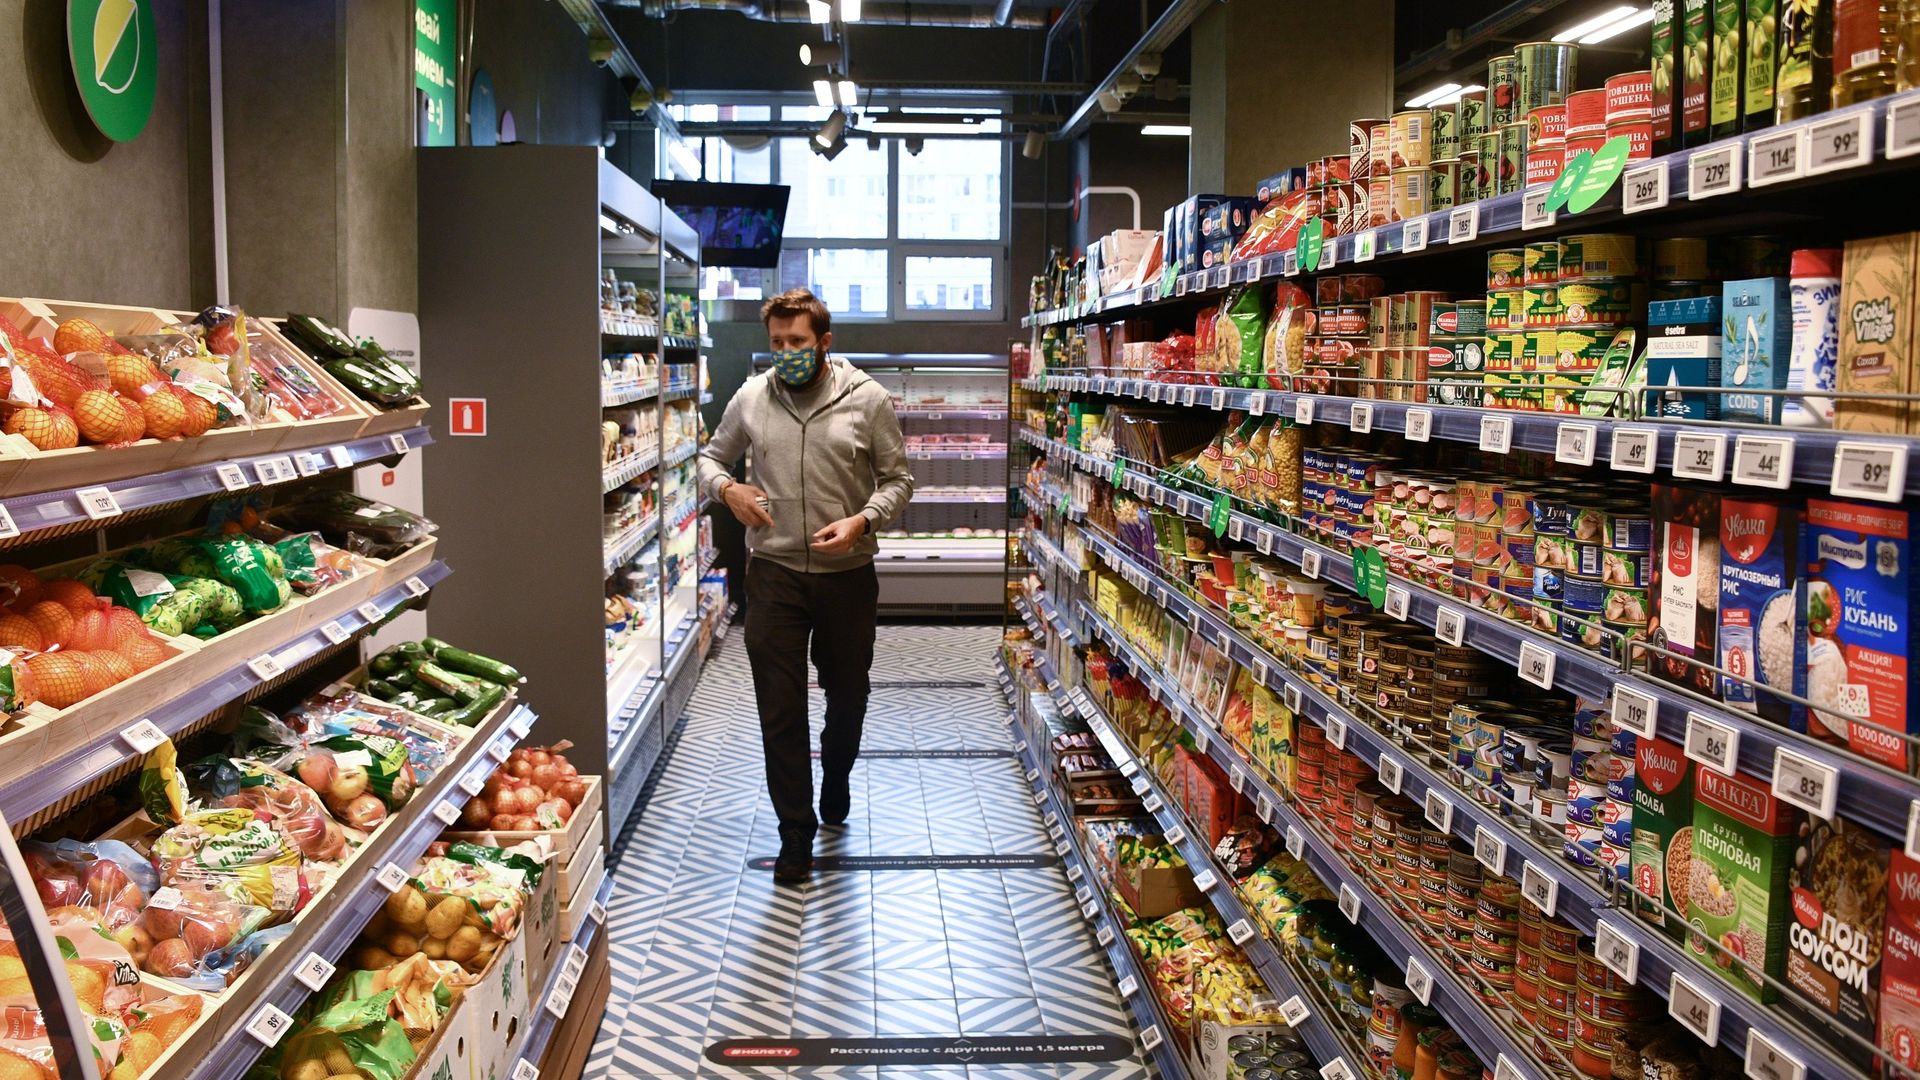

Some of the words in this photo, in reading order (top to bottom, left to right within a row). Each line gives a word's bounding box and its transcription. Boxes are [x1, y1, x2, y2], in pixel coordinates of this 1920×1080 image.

[1833, 133, 1851, 153] 99
[1771, 148, 1789, 168] 114
[1705, 164, 1724, 184] 279
[1636, 182, 1653, 199] 269
[1856, 321, 1894, 343] Village
[1728, 394, 1759, 409] СОЛЬ
[1572, 438, 1582, 452] 42
[1629, 445, 1641, 459] 49
[1696, 450, 1708, 466] 32
[1758, 455, 1773, 471] 44
[1863, 464, 1881, 481] 89
[1725, 513, 1766, 540] Увелка
[1722, 564, 1781, 588] КРУГЛОЗЕРНЫЙ
[1673, 585, 1684, 596] РИС
[1722, 579, 1740, 597] РИС
[1845, 588, 1866, 605] РИС
[1844, 605, 1898, 632] КУБАНЬ
[1858, 650, 1892, 668] АКЦИЯ!
[1628, 704, 1642, 722] 119
[1706, 737, 1720, 755] 86
[1639, 747, 1677, 776] Увелка
[1704, 773, 1762, 815] MAKFA
[1801, 778, 1816, 797] 83
[1635, 789, 1665, 817] ПОЛБА
[1713, 823, 1744, 845] КРУПА
[1699, 829, 1761, 874] ПЕРЛОВАЯ
[1794, 893, 1818, 921] Увелка
[1820, 912, 1868, 963] ПОД
[1613, 946, 1623, 962] 99
[1790, 922, 1868, 994] СОУСОМ
[268, 1017, 279, 1029] 89
[1689, 1004, 1703, 1024] 44
[731, 1047, 793, 1057] #налету
[830, 1046, 929, 1055] Расстаньтесь
[943, 1045, 1011, 1055] другими
[1037, 1045, 1055, 1053] 1,5
[1057, 1044, 1105, 1053] метра
[1899, 1036, 1910, 1059] 5
